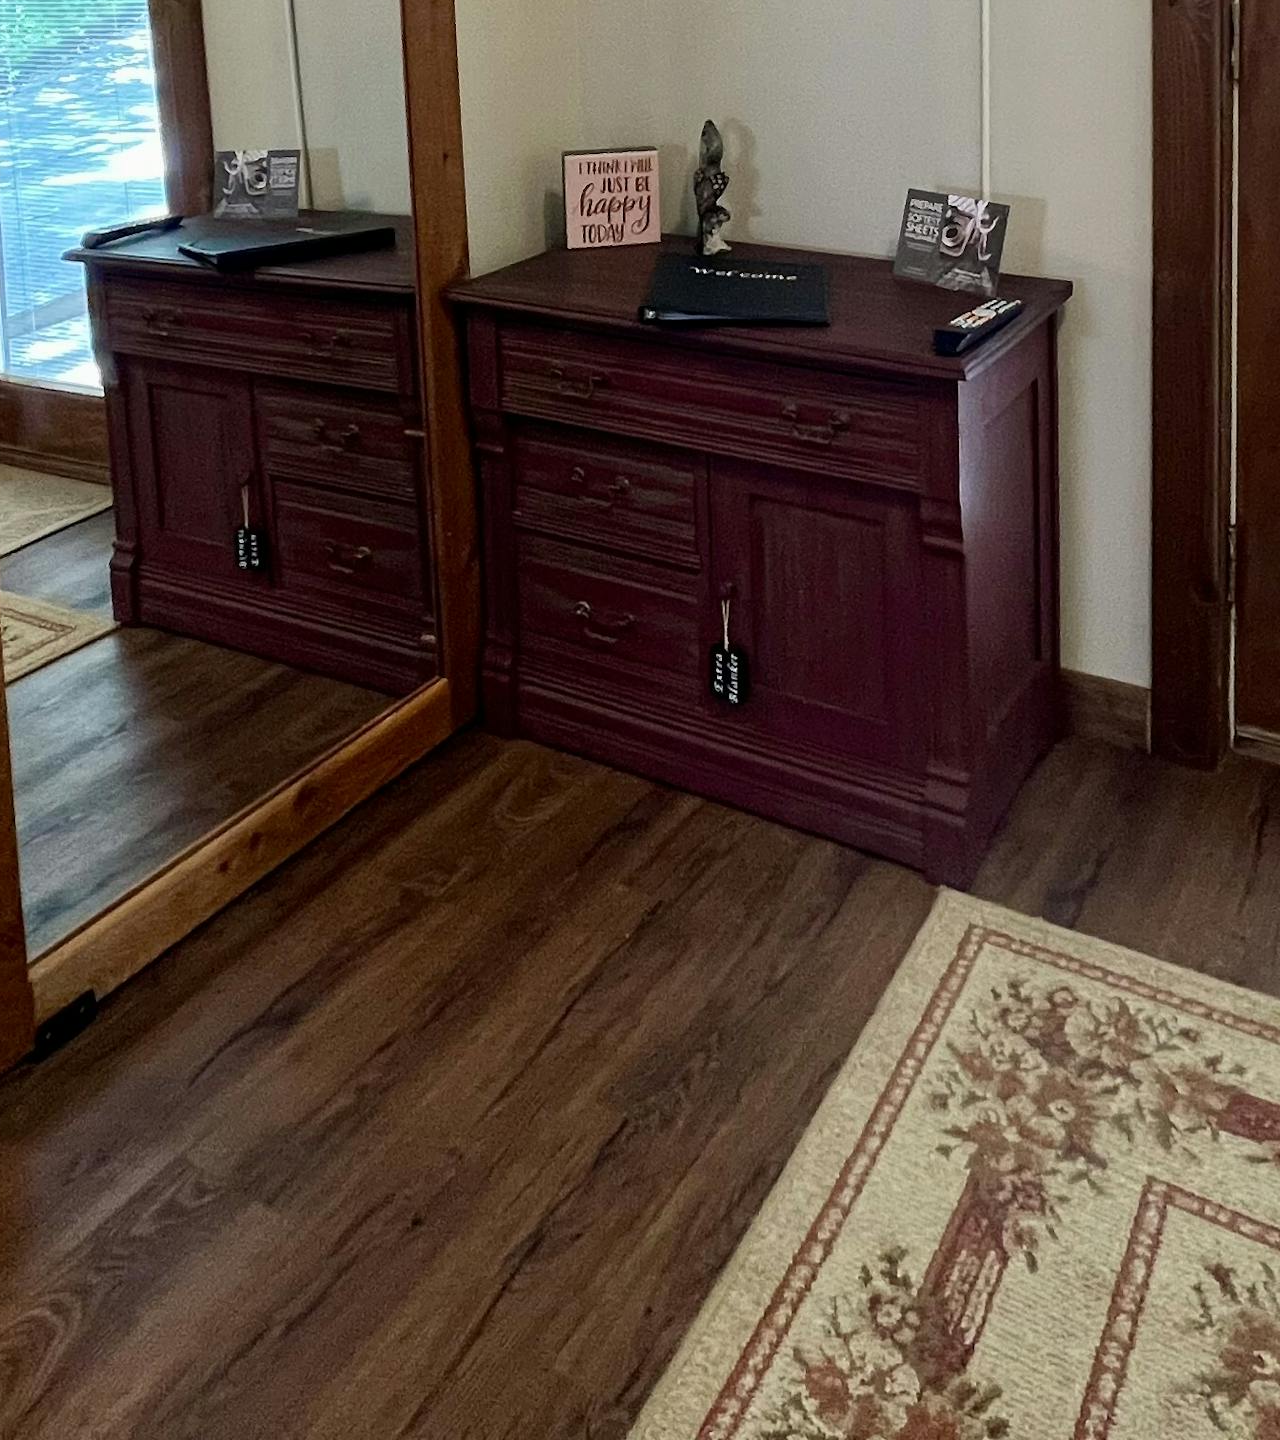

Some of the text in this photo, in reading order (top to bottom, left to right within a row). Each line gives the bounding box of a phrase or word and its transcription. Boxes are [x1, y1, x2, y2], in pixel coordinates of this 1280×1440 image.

[586, 159, 620, 175] THINK
[631, 157, 654, 173] WILL
[600, 175, 651, 193] JUST BE
[579, 182, 651, 235] happy
[582, 223, 625, 244] TODAY
[905, 221, 940, 236] SHEETS
[689, 266, 798, 281] Welcome
[714, 654, 724, 693] Extra
